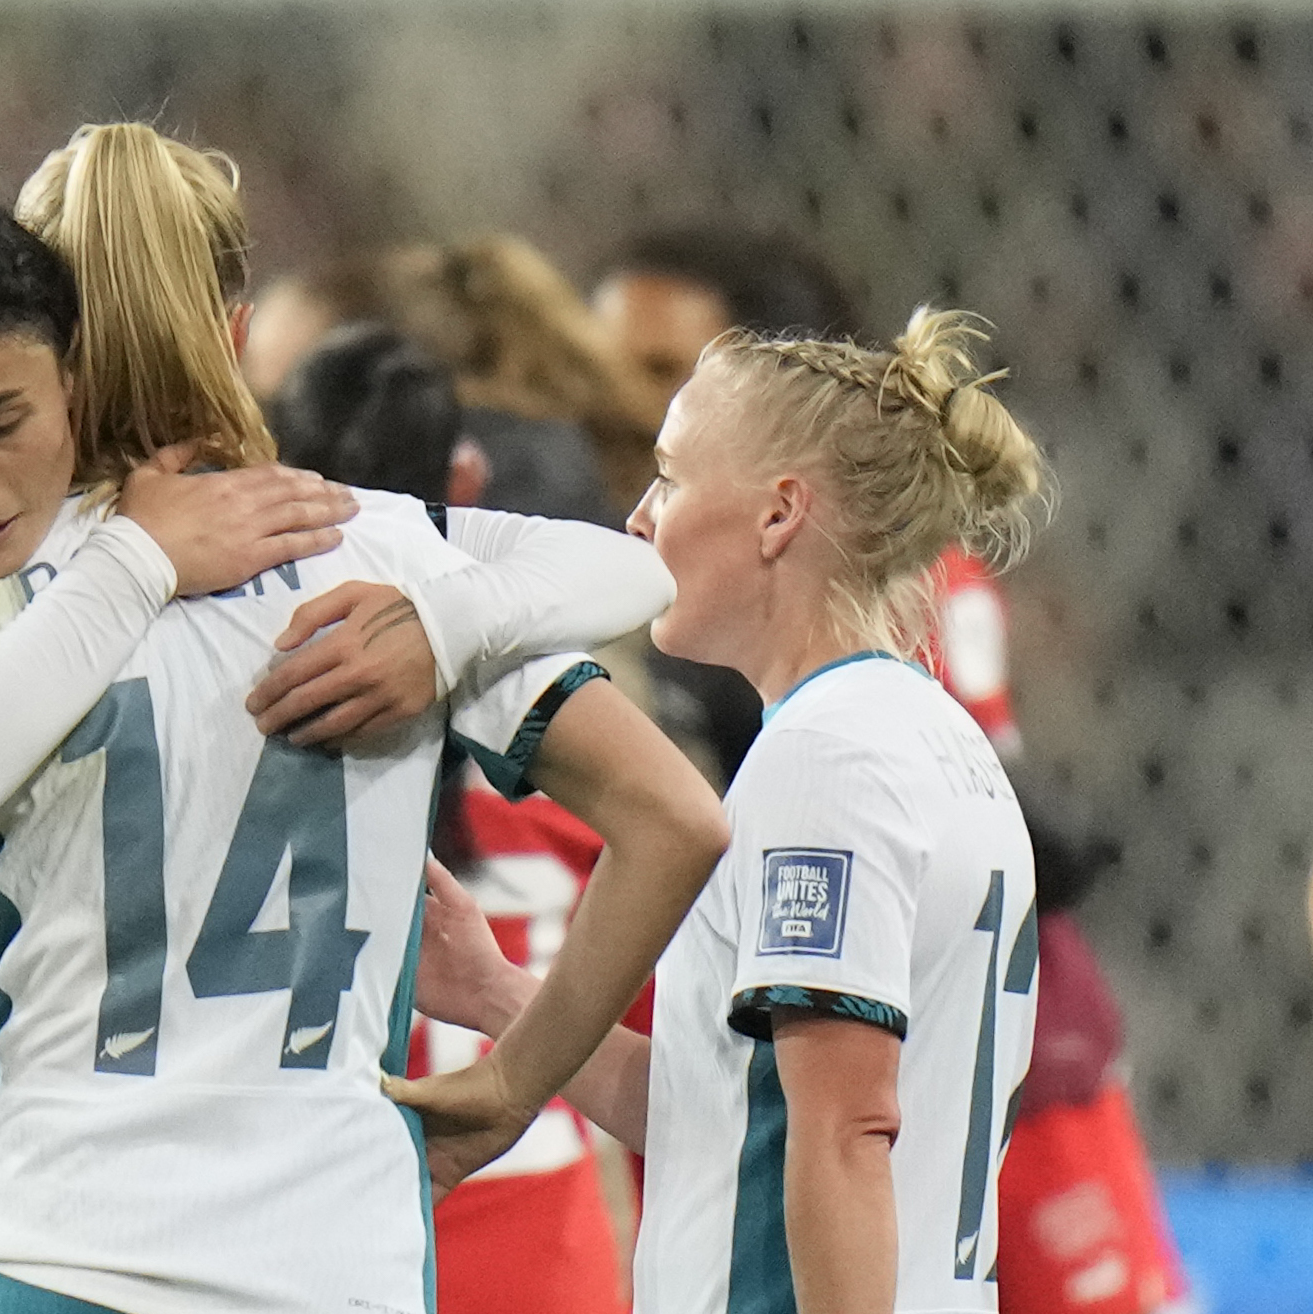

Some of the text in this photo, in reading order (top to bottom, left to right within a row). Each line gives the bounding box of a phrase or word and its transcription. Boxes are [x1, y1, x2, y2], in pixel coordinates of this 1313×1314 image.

[60, 675, 371, 1077] 14
[777, 864, 829, 882] FOOTBALL
[776, 880, 829, 902] UNITES
[771, 899, 830, 921] the World
